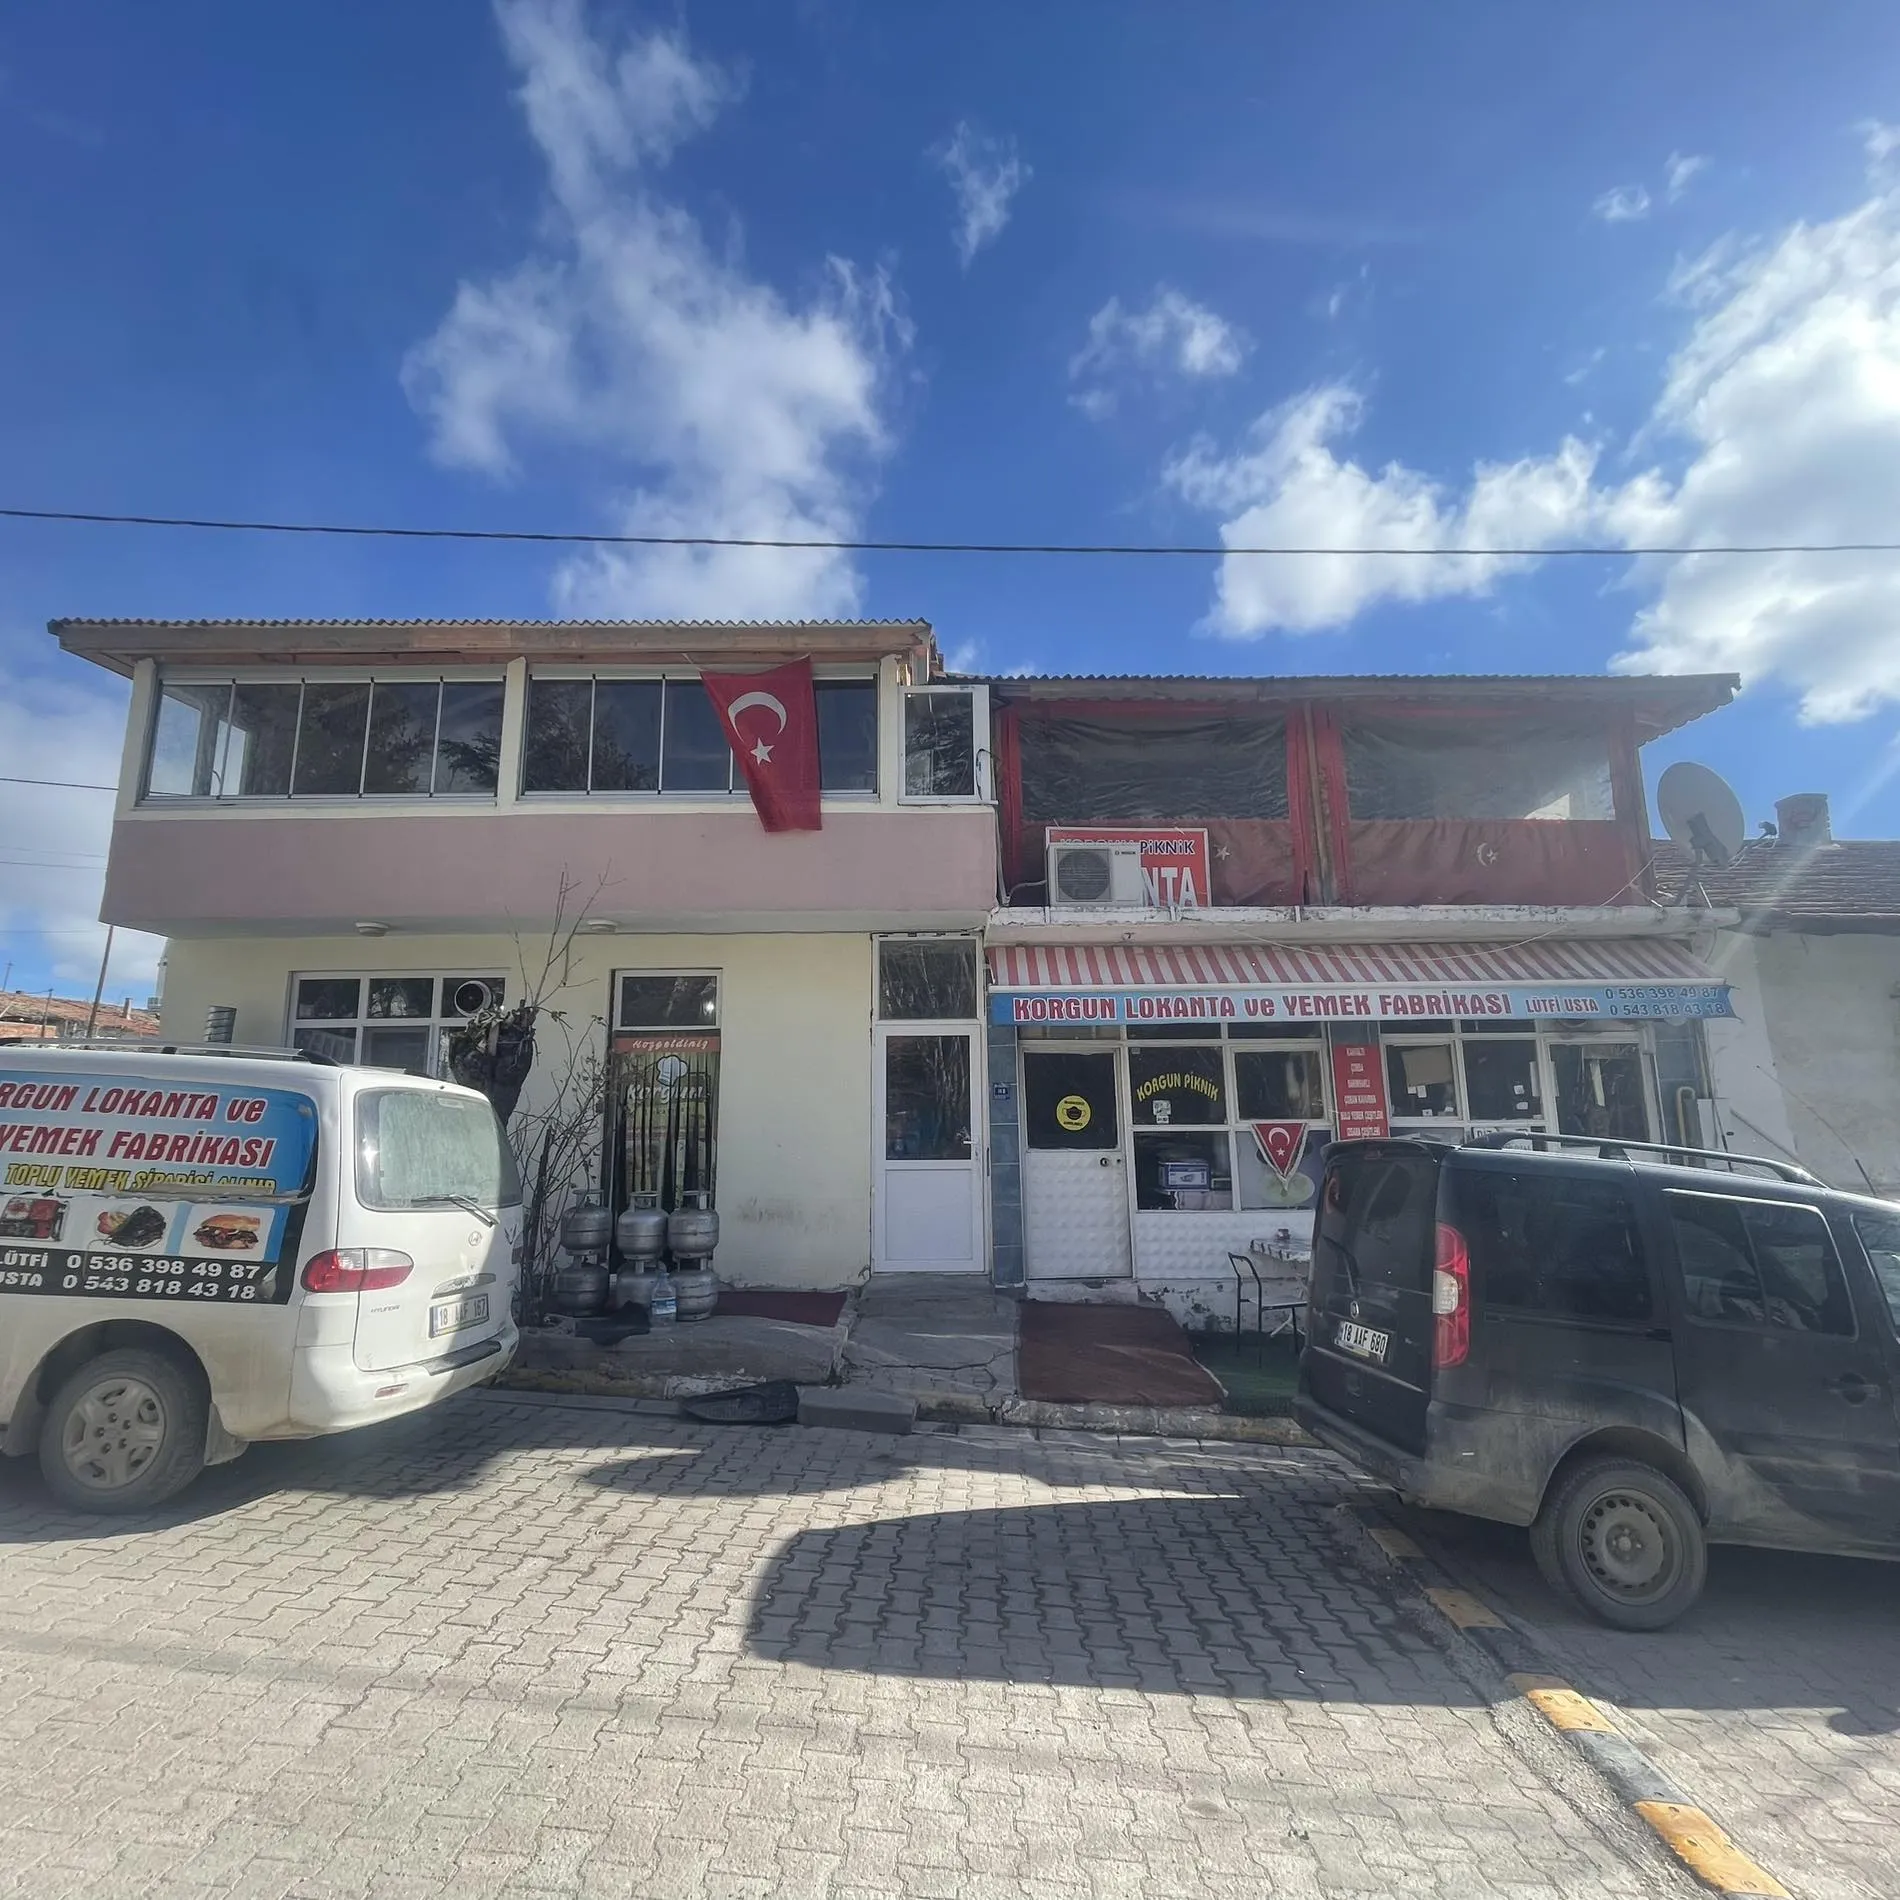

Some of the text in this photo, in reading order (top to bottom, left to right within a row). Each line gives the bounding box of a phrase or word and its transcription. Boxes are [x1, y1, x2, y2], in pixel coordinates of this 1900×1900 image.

[1014, 990, 1599, 1020] KORGUN LOKANTA ve YEMEK FABRİKASI LÜTFİ USTA
[1605, 987, 1718, 999] 0 536 398 49 87
[1610, 1003, 1725, 1016] 0 543 818 43 18
[1136, 1070, 1219, 1102] KORGUN PİKNİK
[81, 1087, 219, 1120] LOKANTA
[226, 1098, 267, 1122] ve
[0, 1124, 275, 1168] YEMEK FABRİKASI
[5, 1163, 64, 1187] TOPLU
[64, 1166, 132, 1191] YEMEK
[67, 1254, 82, 1269] 0
[89, 1256, 133, 1272] 536
[140, 1259, 185, 1275] 398
[192, 1262, 222, 1277] 49
[229, 1264, 260, 1279] 87
[63, 1274, 78, 1289] 0
[84, 1275, 129, 1292] 543
[136, 1279, 181, 1295] 818
[188, 1281, 219, 1297] 43
[228, 1284, 256, 1299] 18
[440, 1307, 448, 1326] 18
[1343, 1323, 1353, 1341] 18
[1370, 1333, 1386, 1353] 680
